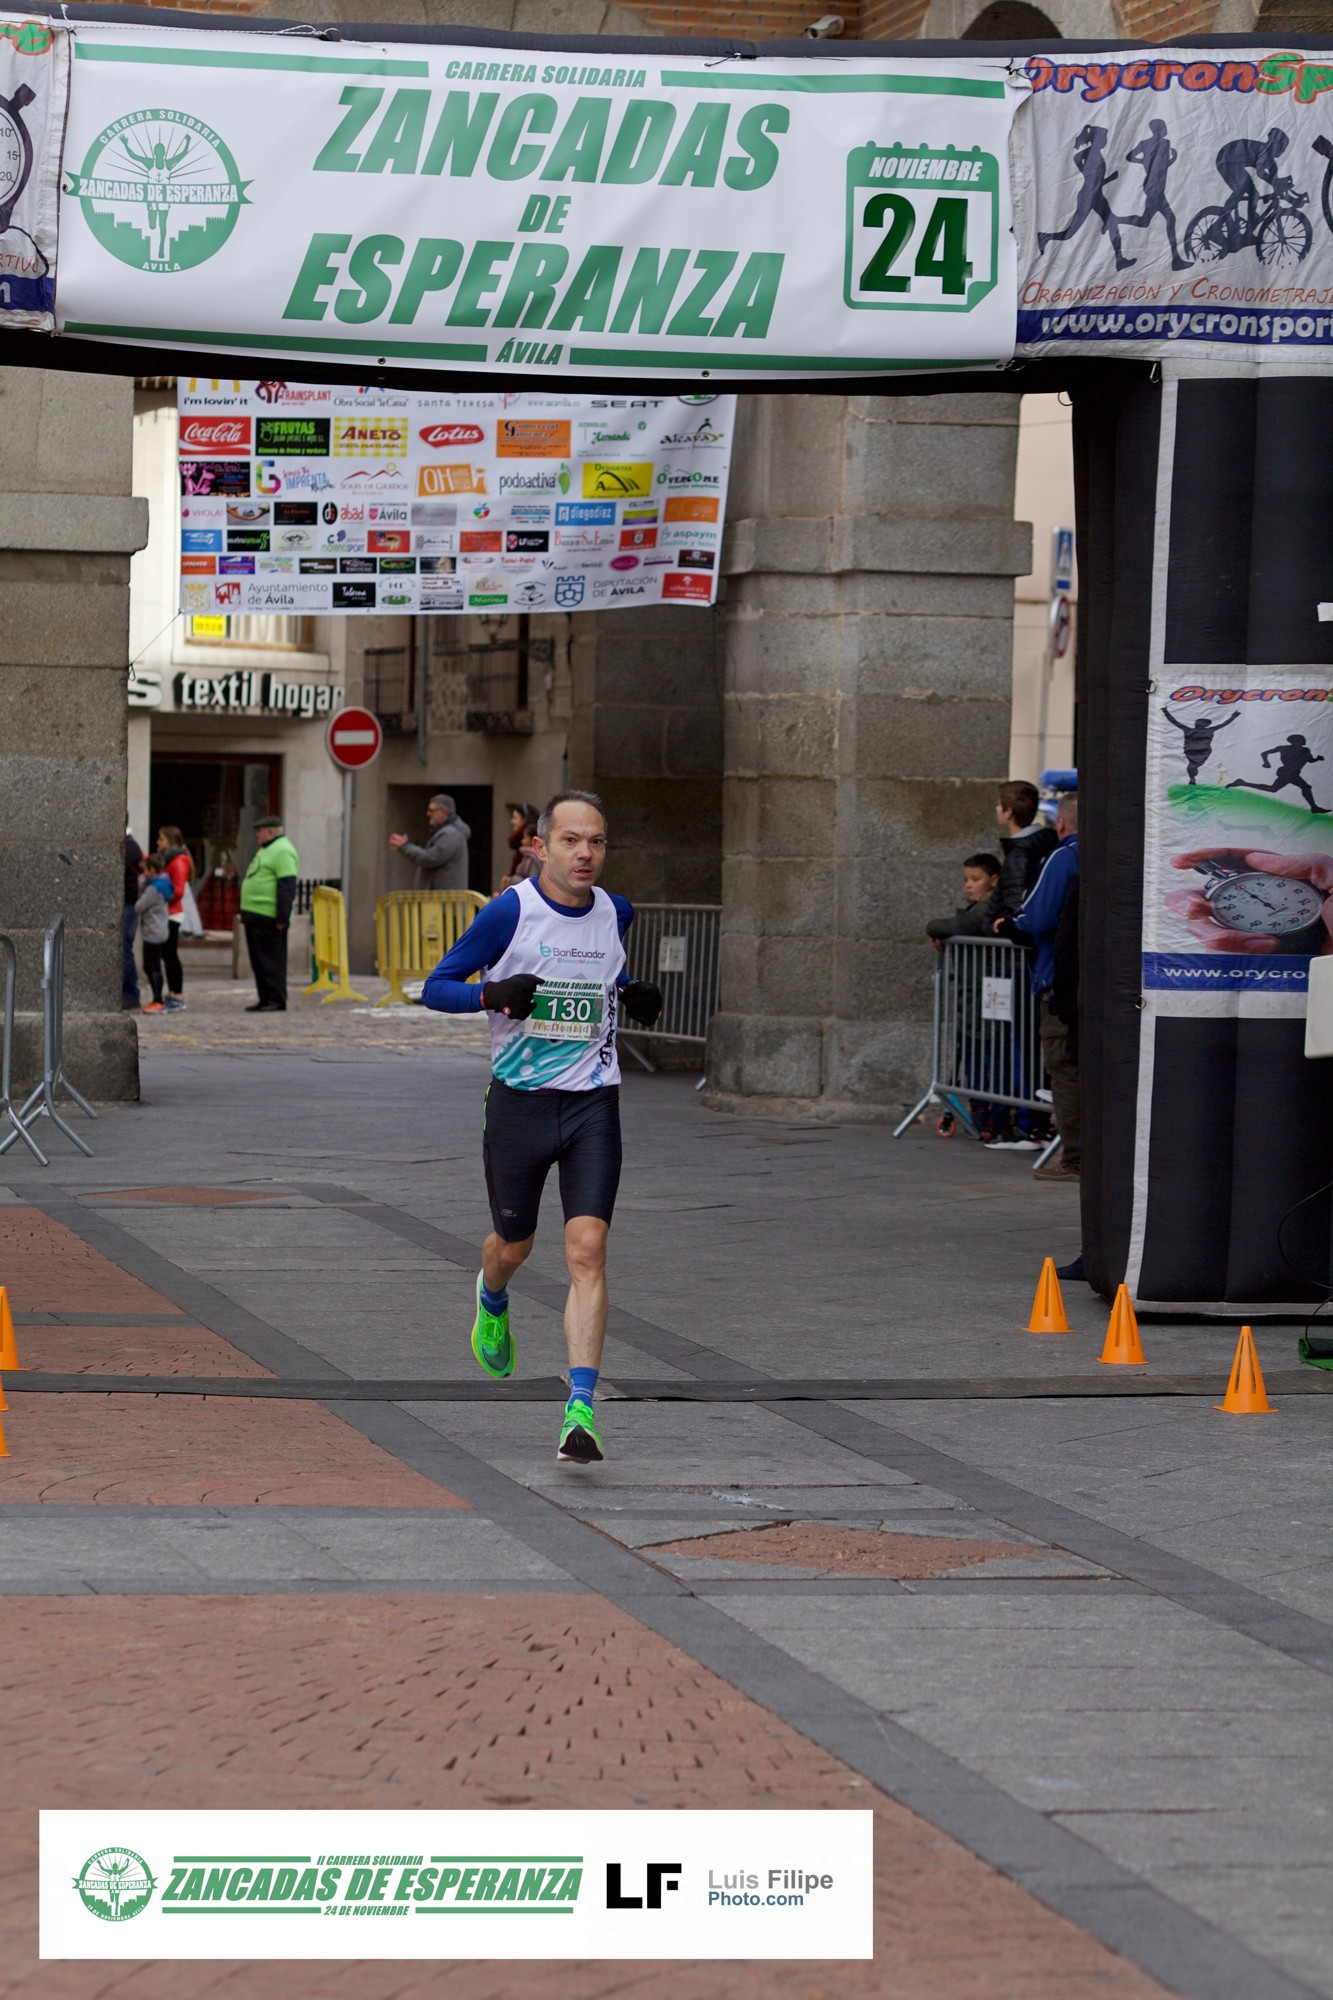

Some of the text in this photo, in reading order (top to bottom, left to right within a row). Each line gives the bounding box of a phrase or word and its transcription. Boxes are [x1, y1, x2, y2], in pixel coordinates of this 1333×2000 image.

[445, 60, 647, 88] CARRERA SOLIDARIA
[99, 109, 222, 148] CARRERA SOLIDARIA
[312, 85, 790, 191] ZANCADAS
[867, 155, 984, 183] NOVIEMBRE
[78, 177, 240, 204] ZANCADAS DE ESPERANZA
[517, 194, 572, 234] DE
[858, 193, 974, 297] 24
[141, 261, 182, 272] AVILA
[281, 232, 785, 339] ESPERANZA
[1042, 310, 1333, 344] www.orycronspor
[494, 336, 563, 366] ÁVILA
[183, 396, 203, 406] i'm
[239, 397, 249, 406] it
[333, 397, 353, 407] Obra
[354, 397, 375, 407] Social
[590, 400, 665, 408] SEAT
[273, 421, 316, 435] FRUTAS
[340, 426, 402, 441] ANETO
[427, 426, 480, 443] Lotus
[286, 472, 329, 490] IMPRENTA
[499, 473, 556, 496] podoactiva
[379, 508, 408, 521] Ávila
[673, 530, 717, 540] aspaym
[247, 582, 329, 595] Ayuntamiento
[592, 576, 658, 589] DIPUTACIÓN
[247, 592, 295, 605] de Ávila
[592, 589, 608, 598] DE
[181, 671, 257, 707] textil
[268, 672, 345, 718] hogar
[552, 947, 606, 959] BanEcuador
[570, 982, 603, 990] SOLIDARIA
[547, 997, 592, 1022] 130
